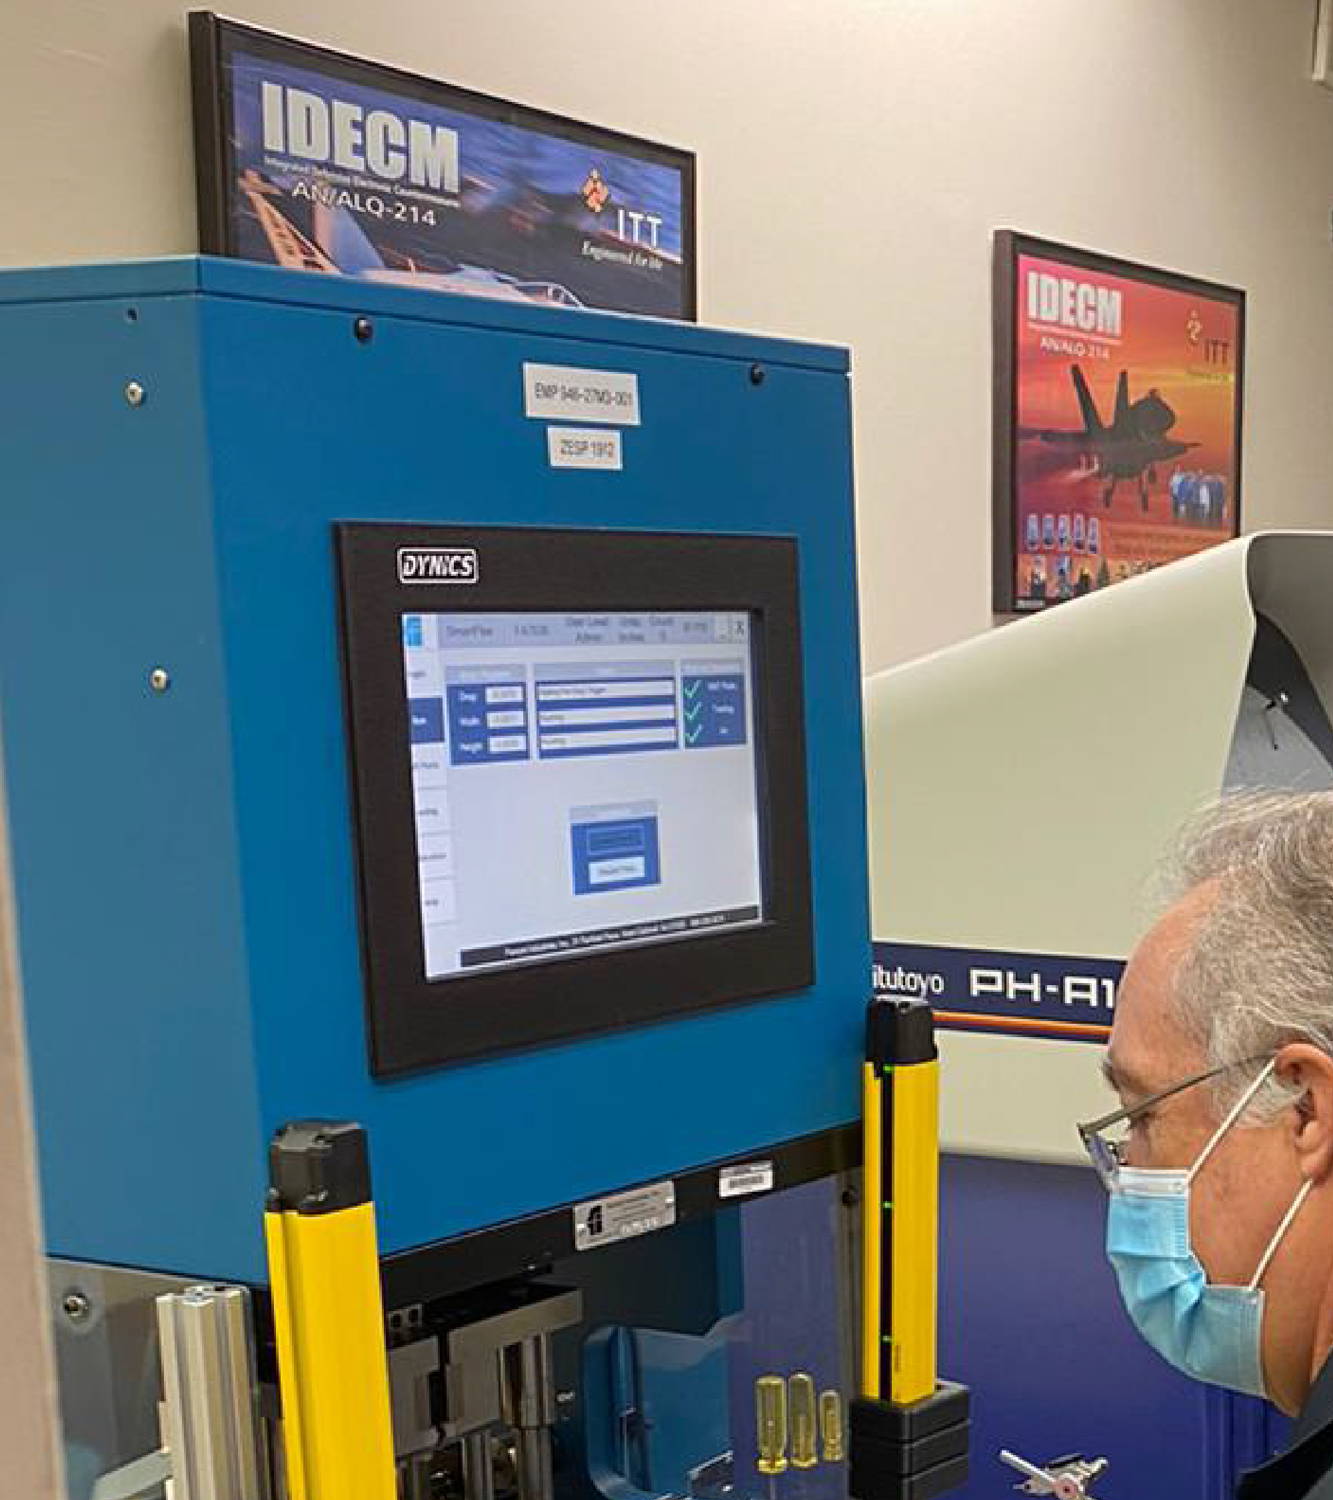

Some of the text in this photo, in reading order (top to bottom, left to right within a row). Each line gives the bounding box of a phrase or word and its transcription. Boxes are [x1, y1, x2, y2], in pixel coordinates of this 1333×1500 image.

[261, 81, 460, 193] IDECM
[292, 181, 437, 226] AN/ALQ-214
[618, 209, 663, 249] ITT
[1026, 271, 1122, 336] IDECM
[1203, 338, 1230, 364] ITT
[403, 555, 473, 577] DYNICS
[872, 964, 945, 1000] itutoyo
